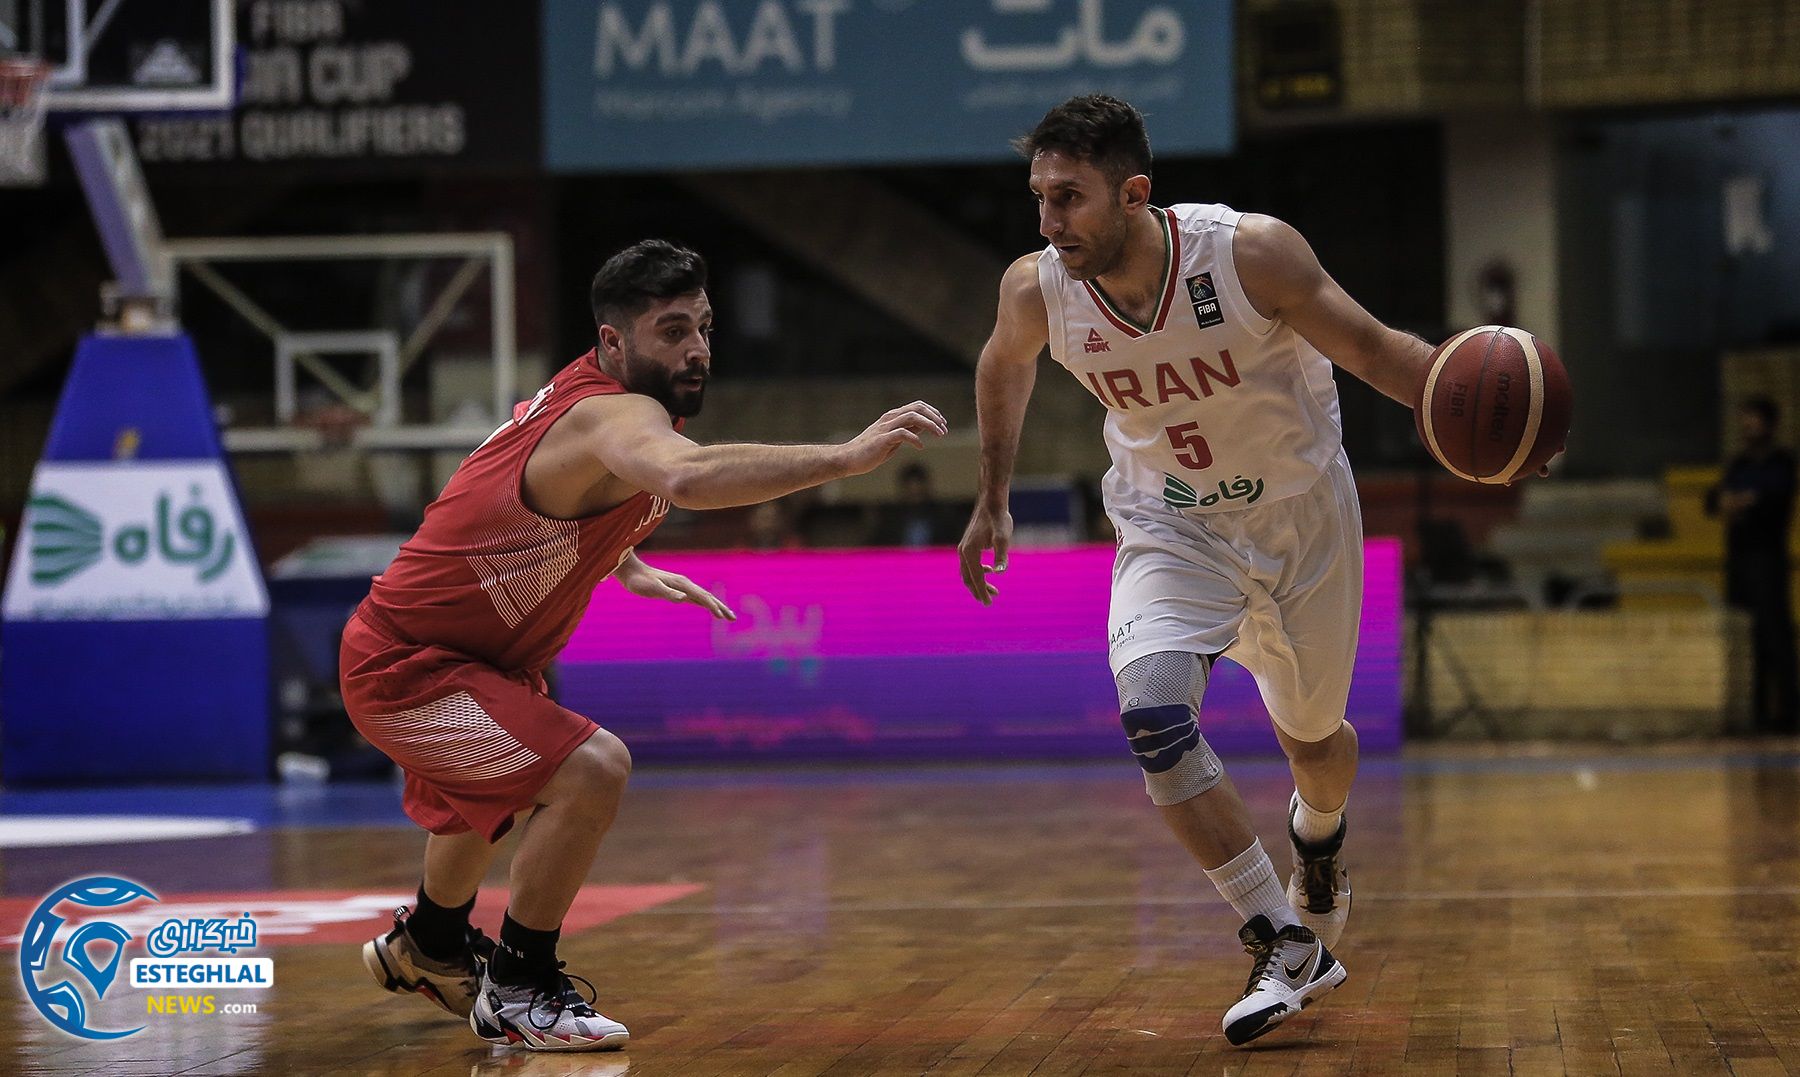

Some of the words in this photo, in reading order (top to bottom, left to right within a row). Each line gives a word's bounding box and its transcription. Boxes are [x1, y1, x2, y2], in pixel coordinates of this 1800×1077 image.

[593, 0, 853, 77] MAAT
[310, 42, 410, 100] CUP
[241, 104, 465, 159] QUALIFIERS
[1198, 302, 1217, 315] FIBA
[1086, 349, 1240, 409] IRAN
[1489, 372, 1511, 440] molten
[1165, 421, 1213, 470] 5
[1200, 475, 1264, 507] رفاه
[114, 484, 235, 583] رفاه
